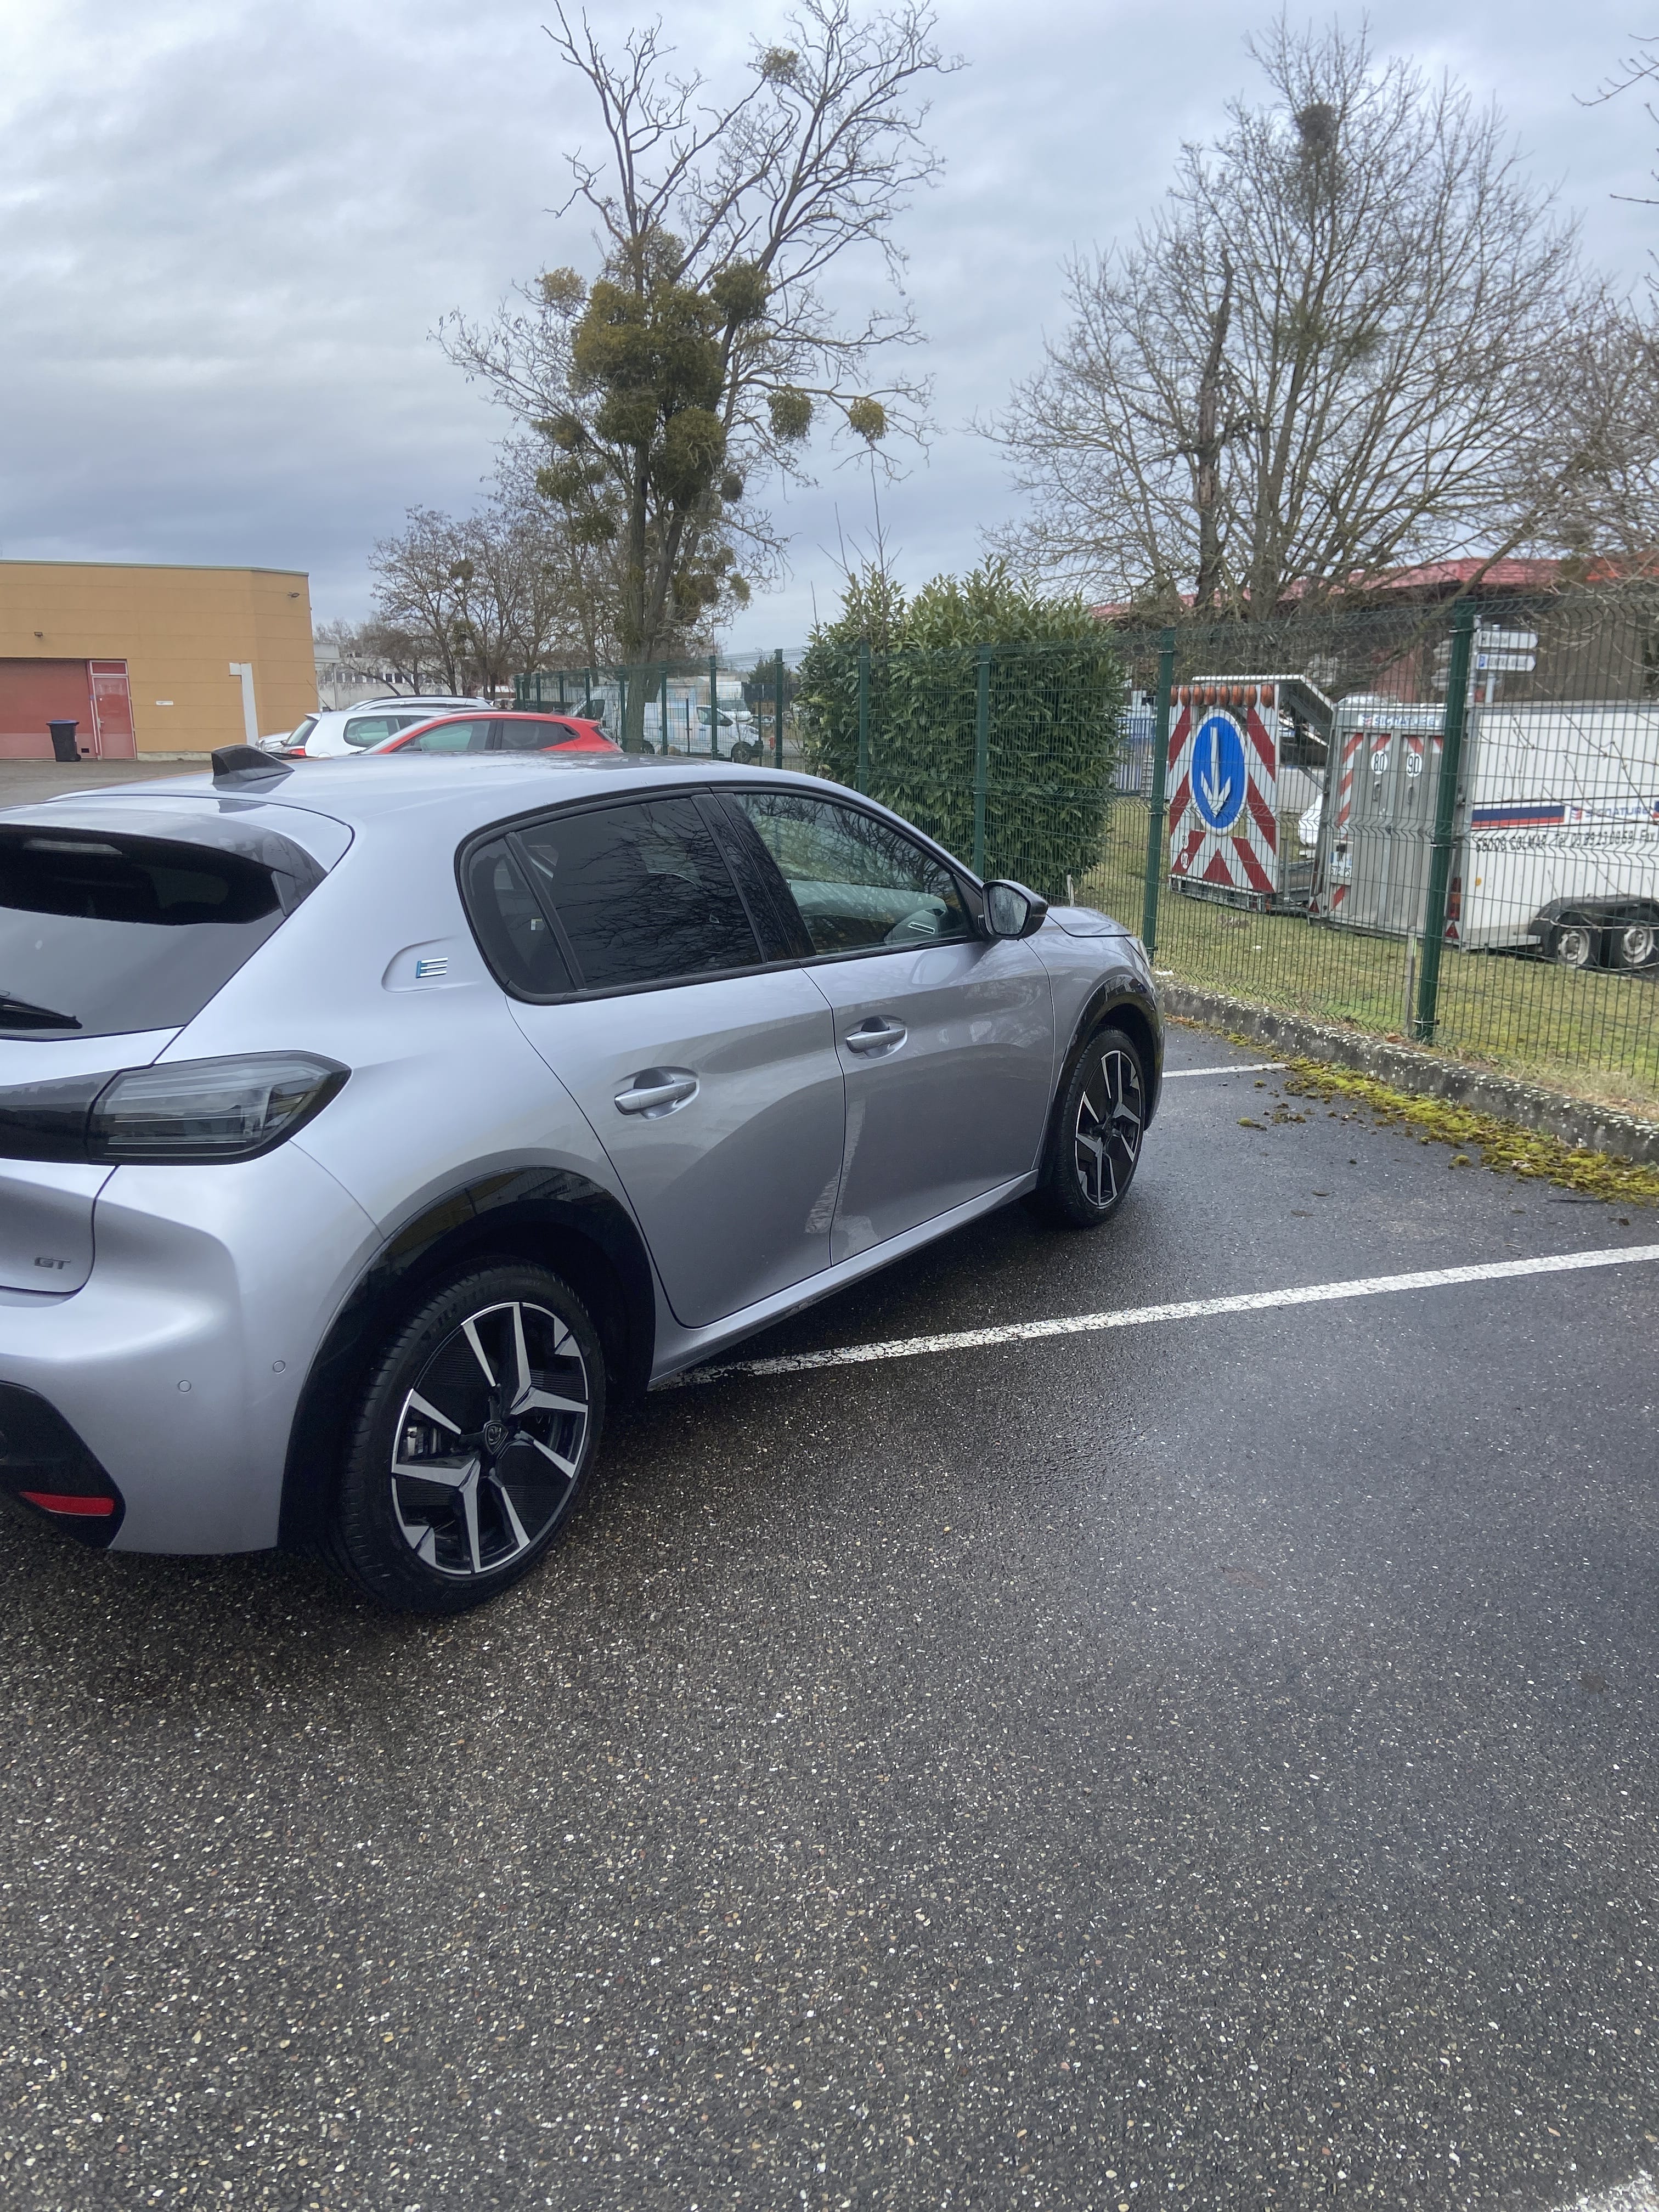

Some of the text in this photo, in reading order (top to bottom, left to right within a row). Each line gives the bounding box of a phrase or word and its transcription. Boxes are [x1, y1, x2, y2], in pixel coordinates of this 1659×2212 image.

[1374, 753, 1385, 772] 80
[1408, 755, 1420, 774] 90
[35, 1257, 70, 1270] GT
